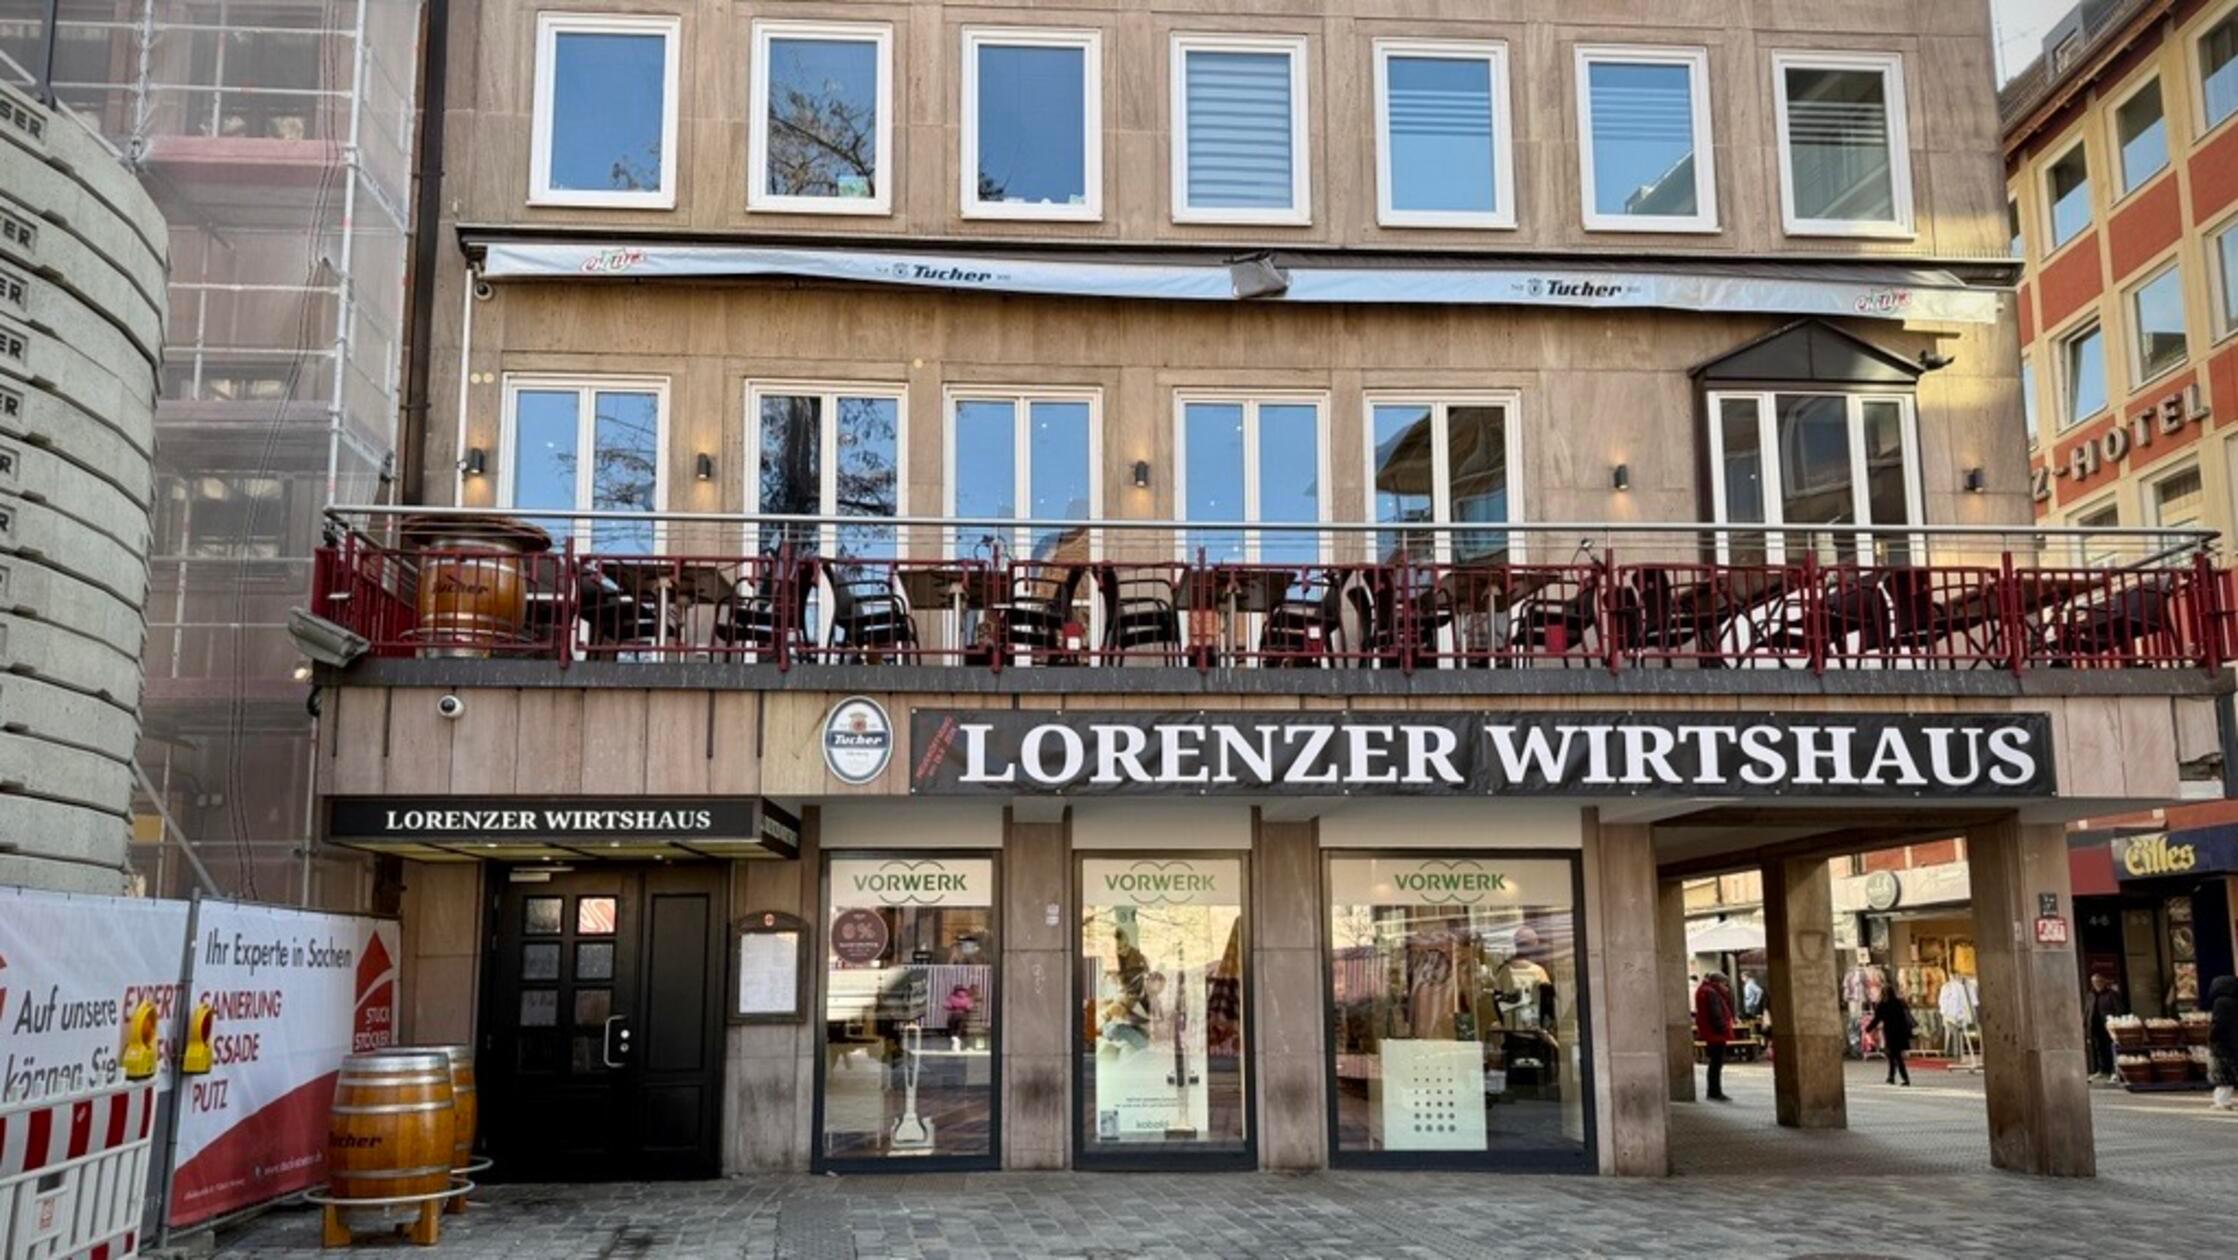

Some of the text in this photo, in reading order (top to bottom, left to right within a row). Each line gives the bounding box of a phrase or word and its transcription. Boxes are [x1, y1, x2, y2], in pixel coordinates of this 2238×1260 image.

[913, 264, 992, 282] Tucher
[1547, 279, 1622, 297] Tucher
[833, 733, 883, 745] Tucher
[958, 723, 1464, 784] LORENZER
[1484, 724, 2037, 786] WIRTSHAUS
[386, 810, 712, 830] LORENZER WIRTSHAUS
[853, 874, 968, 891] VORWERK
[1104, 874, 1216, 891] VORWERK
[1394, 873, 1507, 891] VORWERK
[205, 927, 353, 977] Ihr Experte in Sachen
[13, 984, 58, 1036] Auf
[60, 999, 117, 1032] unsere
[213, 1034, 260, 1065] SSADE
[192, 1079, 229, 1114] PUTZ
